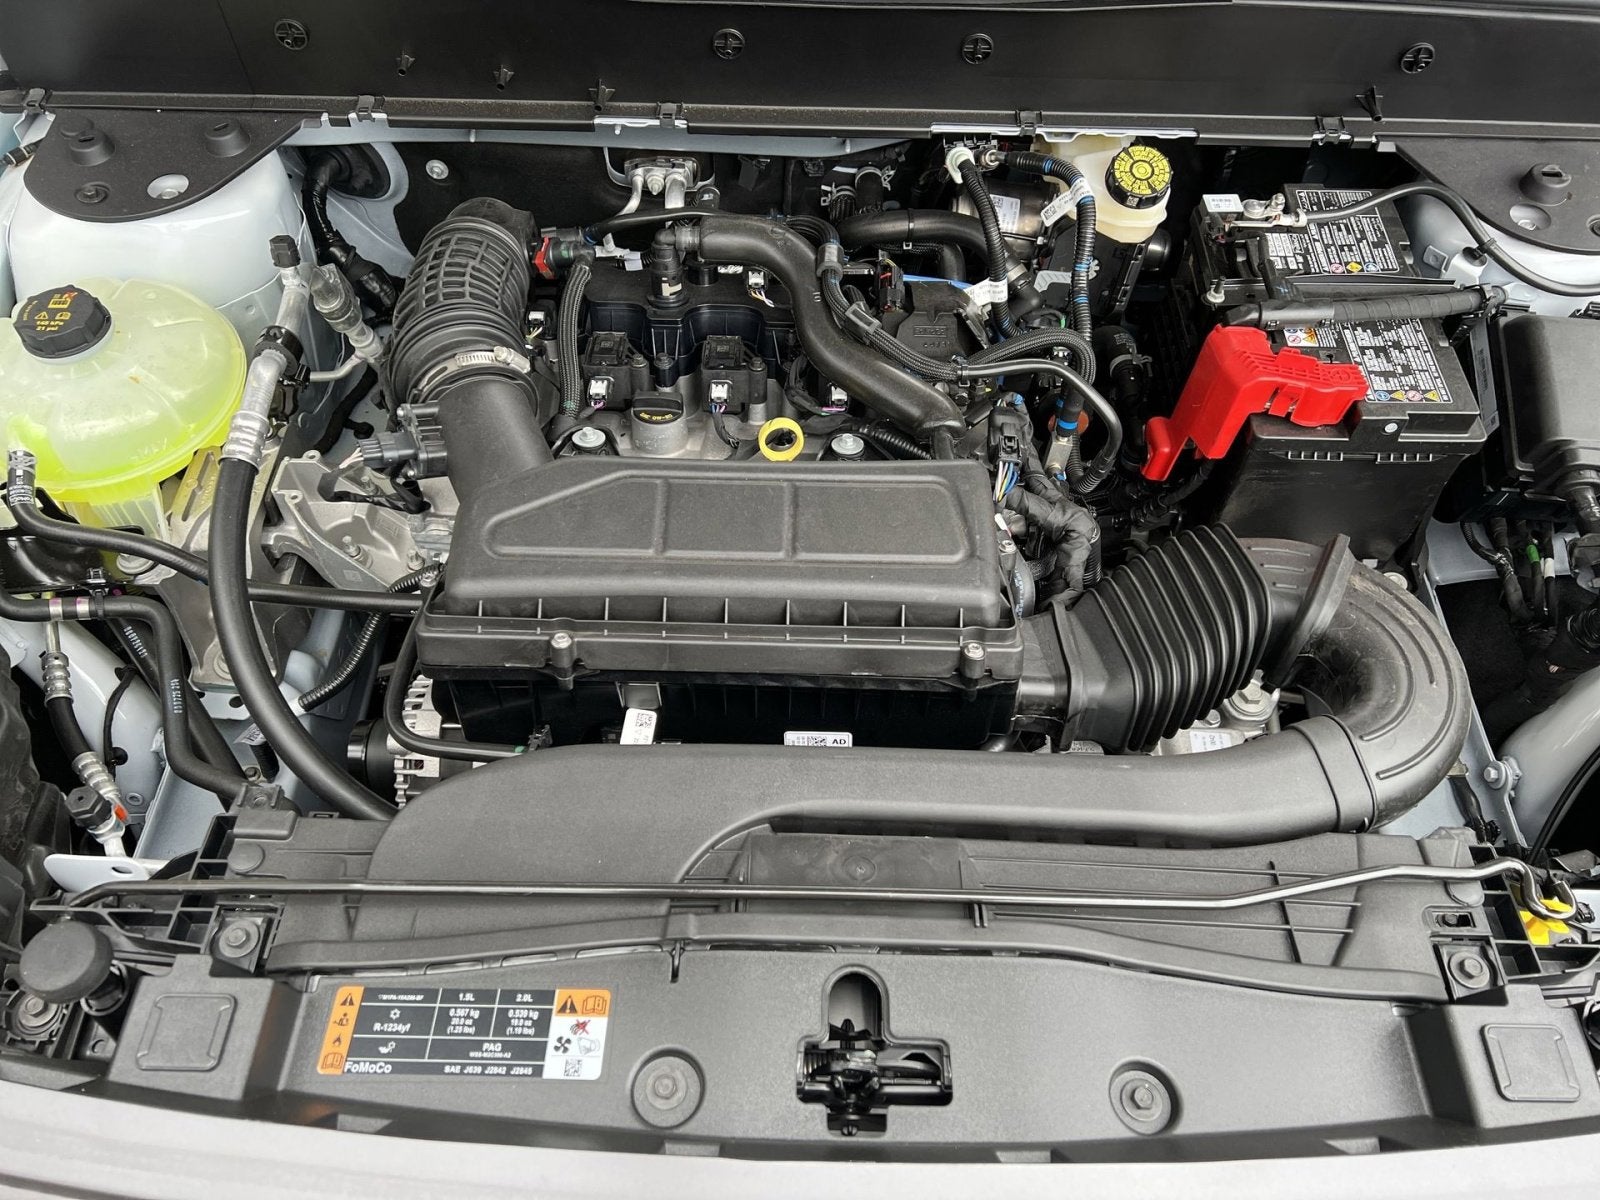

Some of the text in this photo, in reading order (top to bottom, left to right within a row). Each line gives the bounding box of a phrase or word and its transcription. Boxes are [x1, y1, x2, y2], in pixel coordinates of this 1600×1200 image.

[458, 993, 475, 1002] 1.5L
[515, 993, 533, 1003] 2.0L
[469, 1009, 480, 1019] kg
[528, 1010, 539, 1020] kg
[373, 1022, 411, 1034] R-1234yf
[482, 1042, 502, 1052] PAG
[344, 1062, 392, 1073] FoMoCo
[444, 1065, 461, 1074] SAE
